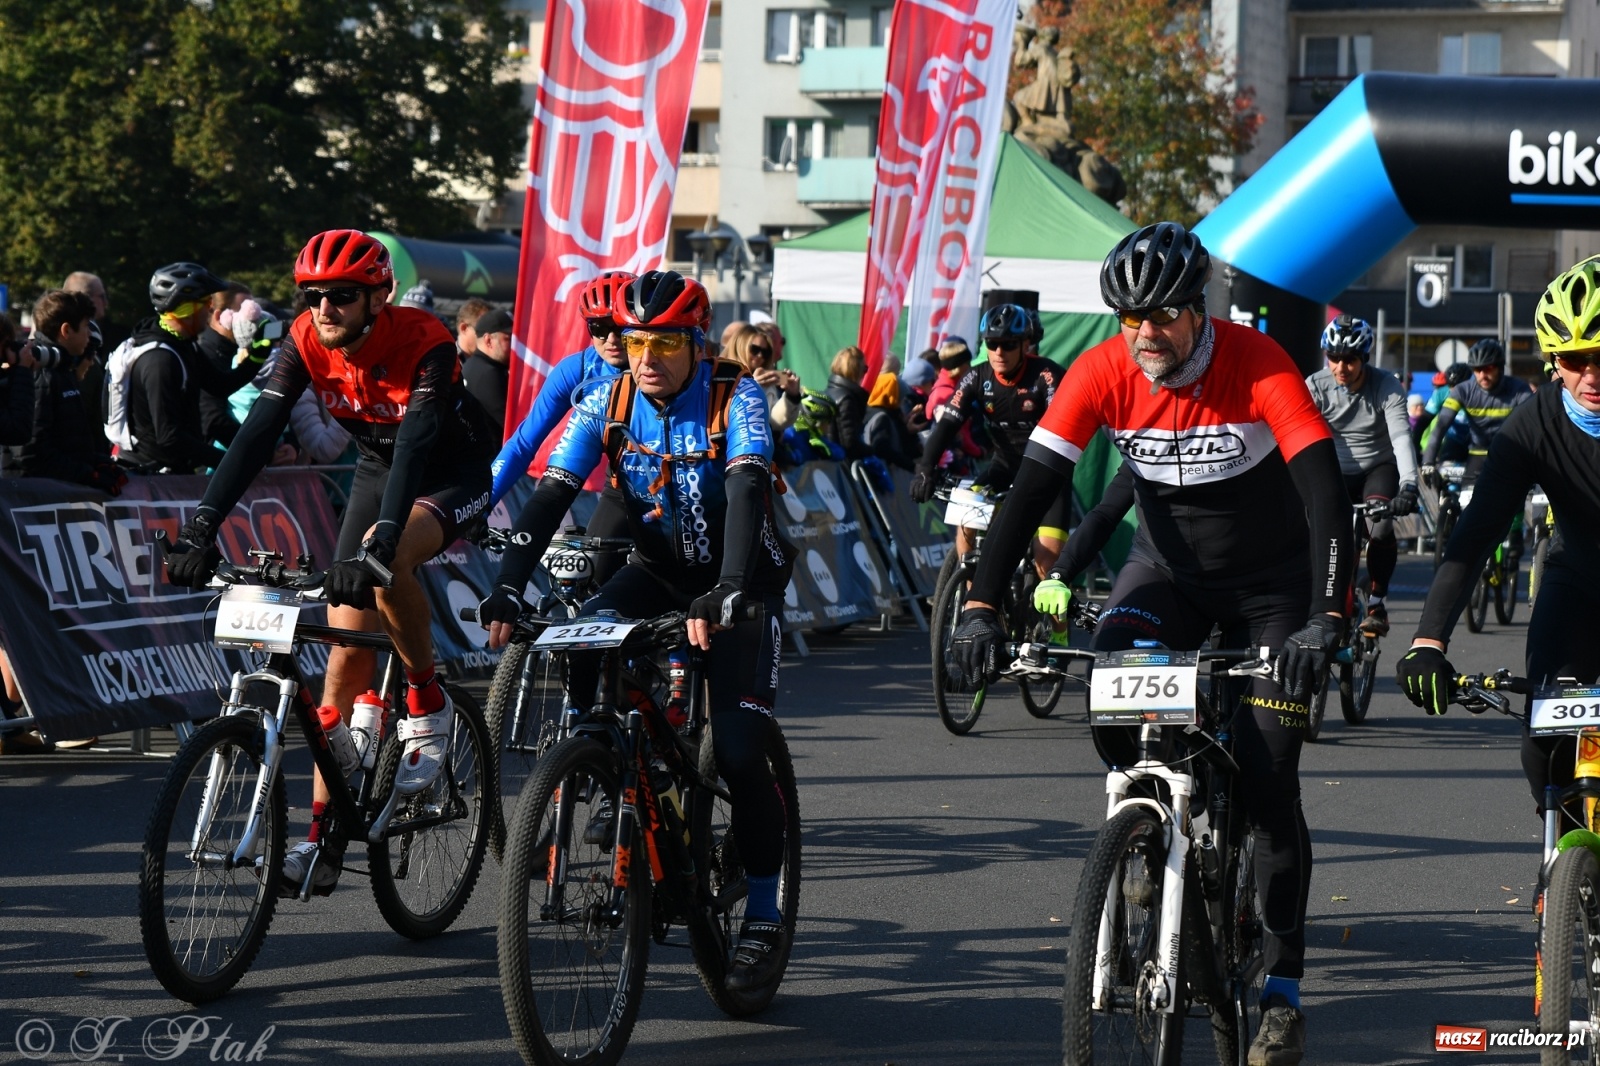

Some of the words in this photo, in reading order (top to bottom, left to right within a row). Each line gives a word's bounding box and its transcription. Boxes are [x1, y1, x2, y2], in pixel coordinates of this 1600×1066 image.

[1508, 128, 1600, 187] bik
[1413, 263, 1449, 274] SEKTOR
[1416, 273, 1443, 308] 0
[1180, 464, 1205, 476] peel
[1207, 465, 1217, 474] &
[1218, 455, 1252, 473] patch
[1326, 538, 1338, 597] BRUBECK
[231, 610, 285, 632] 3164
[553, 626, 617, 639] 2124
[770, 638, 782, 689] WEILANDT
[1111, 675, 1179, 699] 1756
[1168, 932, 1180, 979] ROCKSHOX
